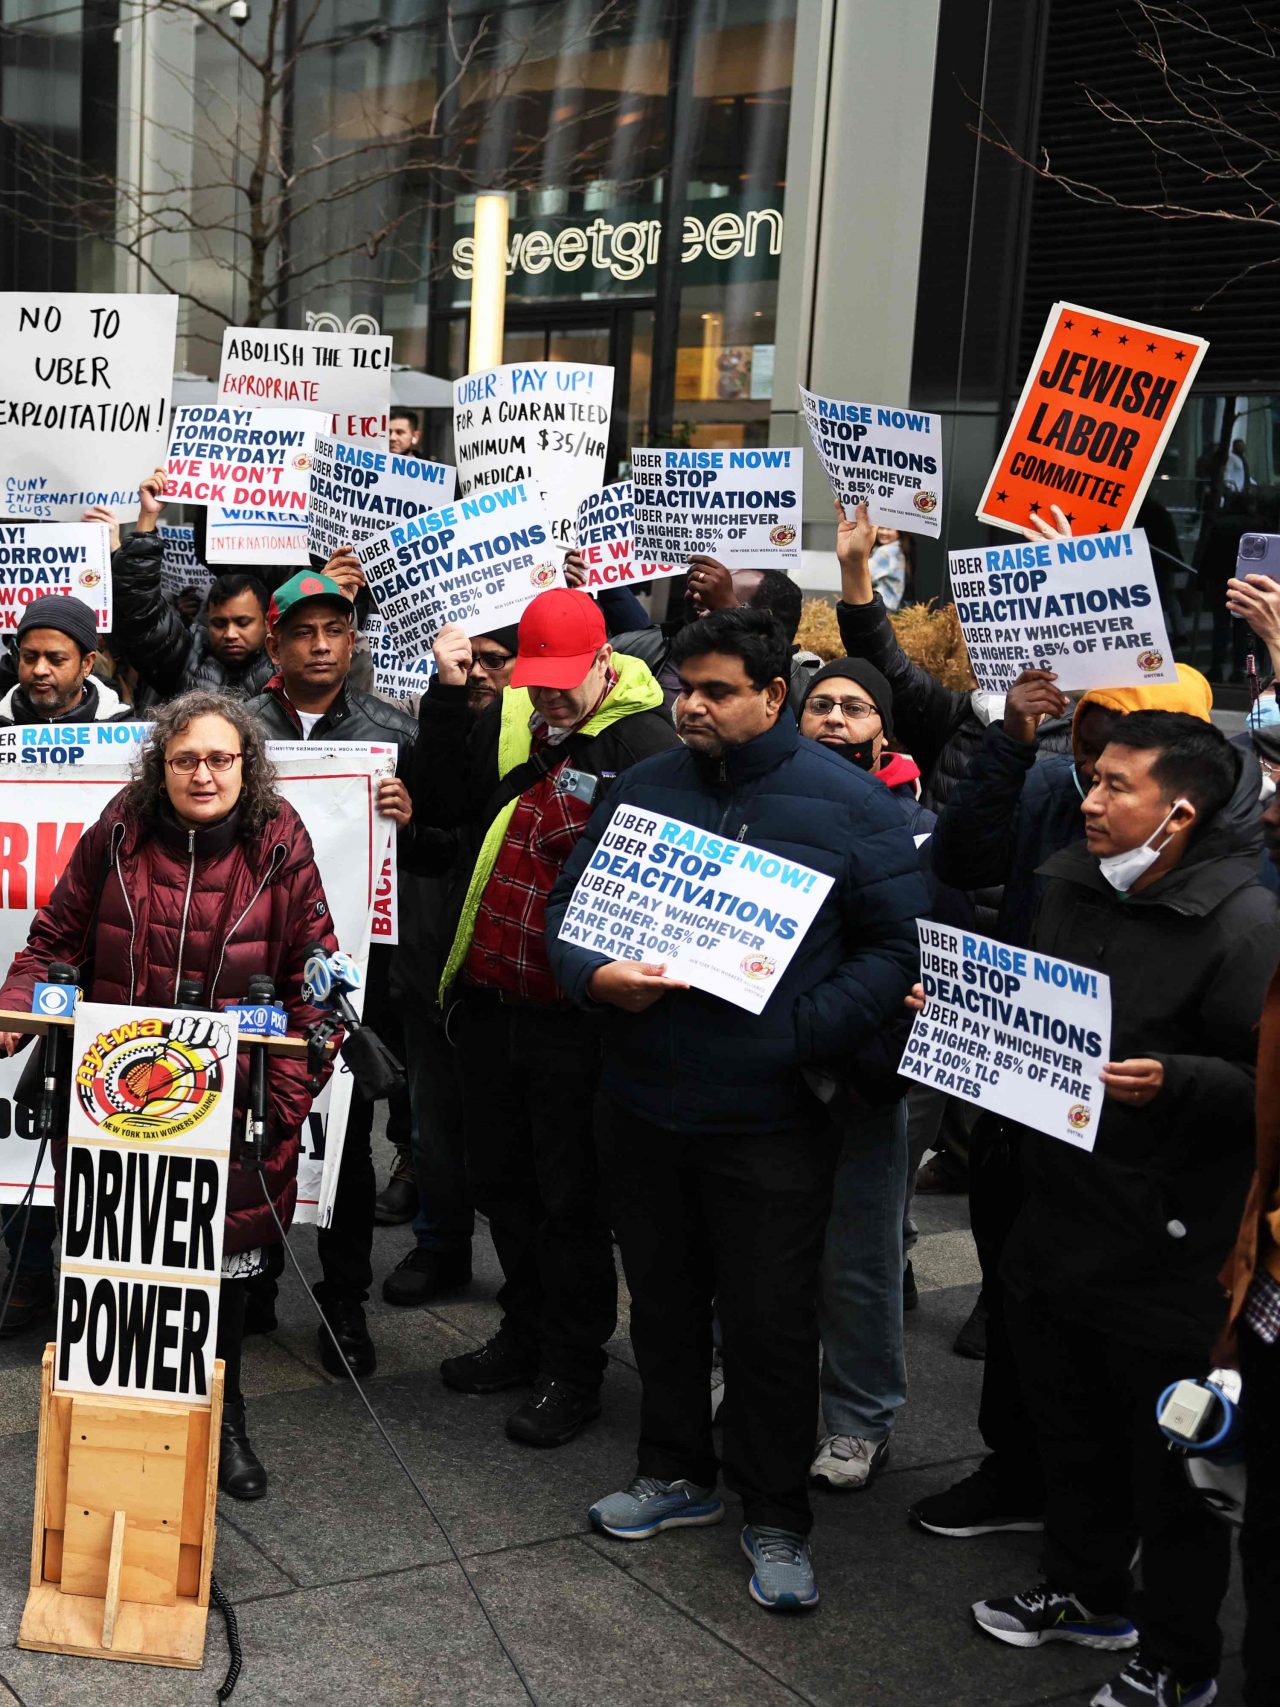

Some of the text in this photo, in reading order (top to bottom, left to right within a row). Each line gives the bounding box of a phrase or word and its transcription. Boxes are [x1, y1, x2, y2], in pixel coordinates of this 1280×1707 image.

[452, 208, 784, 281] seetgreen
[19, 306, 120, 339] NO TO
[35, 357, 111, 389] UBER
[228, 339, 391, 371] ABOLISH THE TLC!
[223, 373, 319, 401] EXPROPRIATE
[512, 368, 548, 395] PAY
[557, 371, 593, 394] UP!
[1039, 349, 1177, 420] JEWISH
[180, 408, 252, 426] TODAY!
[348, 415, 387, 438] ETC!
[457, 401, 608, 432] FOR A GUARANTEED
[818, 400, 930, 433] RAISE NOW!
[820, 418, 867, 441] STOP
[176, 425, 305, 446] TOMORROW!
[459, 429, 605, 463] MINIMUM $35/HR
[1027, 402, 1140, 471] LABOR
[167, 459, 284, 484] WE WON'T
[170, 443, 286, 465] EVERYDAY!
[633, 451, 790, 468] UBER RAISE NOW!
[6, 477, 48, 491] CUNY
[163, 479, 309, 510] BACK DOWN
[634, 470, 717, 488] UBER STOP
[1010, 452, 1125, 508] COMMITTEE
[6, 490, 141, 505] INTERNATIONALIS
[9, 504, 51, 516] CLUBS
[635, 488, 796, 508] DEACTIVATIONS
[211, 536, 308, 550] INTERNATIONALIS
[359, 485, 528, 565] UBER RAISE NOW!
[365, 529, 455, 584] UBER STOP
[372, 525, 546, 604] DEACTIVATIONS
[950, 534, 1133, 575] UBER RAISE NOW!
[953, 570, 1047, 598] UBER STOP
[957, 584, 1151, 623] DEACTIVATIONS
[602, 832, 721, 881] UBER STOP
[613, 811, 817, 894] UBER RAISE NOW!
[590, 850, 798, 940] DEACTIVATIONS
[920, 927, 1098, 999] UBER RAISE NOW!
[922, 951, 1021, 998] UBER STOP
[922, 973, 1102, 1058] DEACTIVATIONS
[75, 1018, 164, 1089] nytwa
[920, 1002, 1082, 1076] UBER PAY WHICHEVER
[901, 1056, 982, 1099] PAY RATES
[908, 1039, 1000, 1085] OR 100% TLC
[913, 1021, 1092, 1101] IS HIGHER: 85% OF FARE
[102, 1092, 217, 1139] NEW YORK TAXI WORKERS ALLIANCE
[64, 1146, 219, 1271] DRIVER
[58, 1276, 210, 1396] POWER
